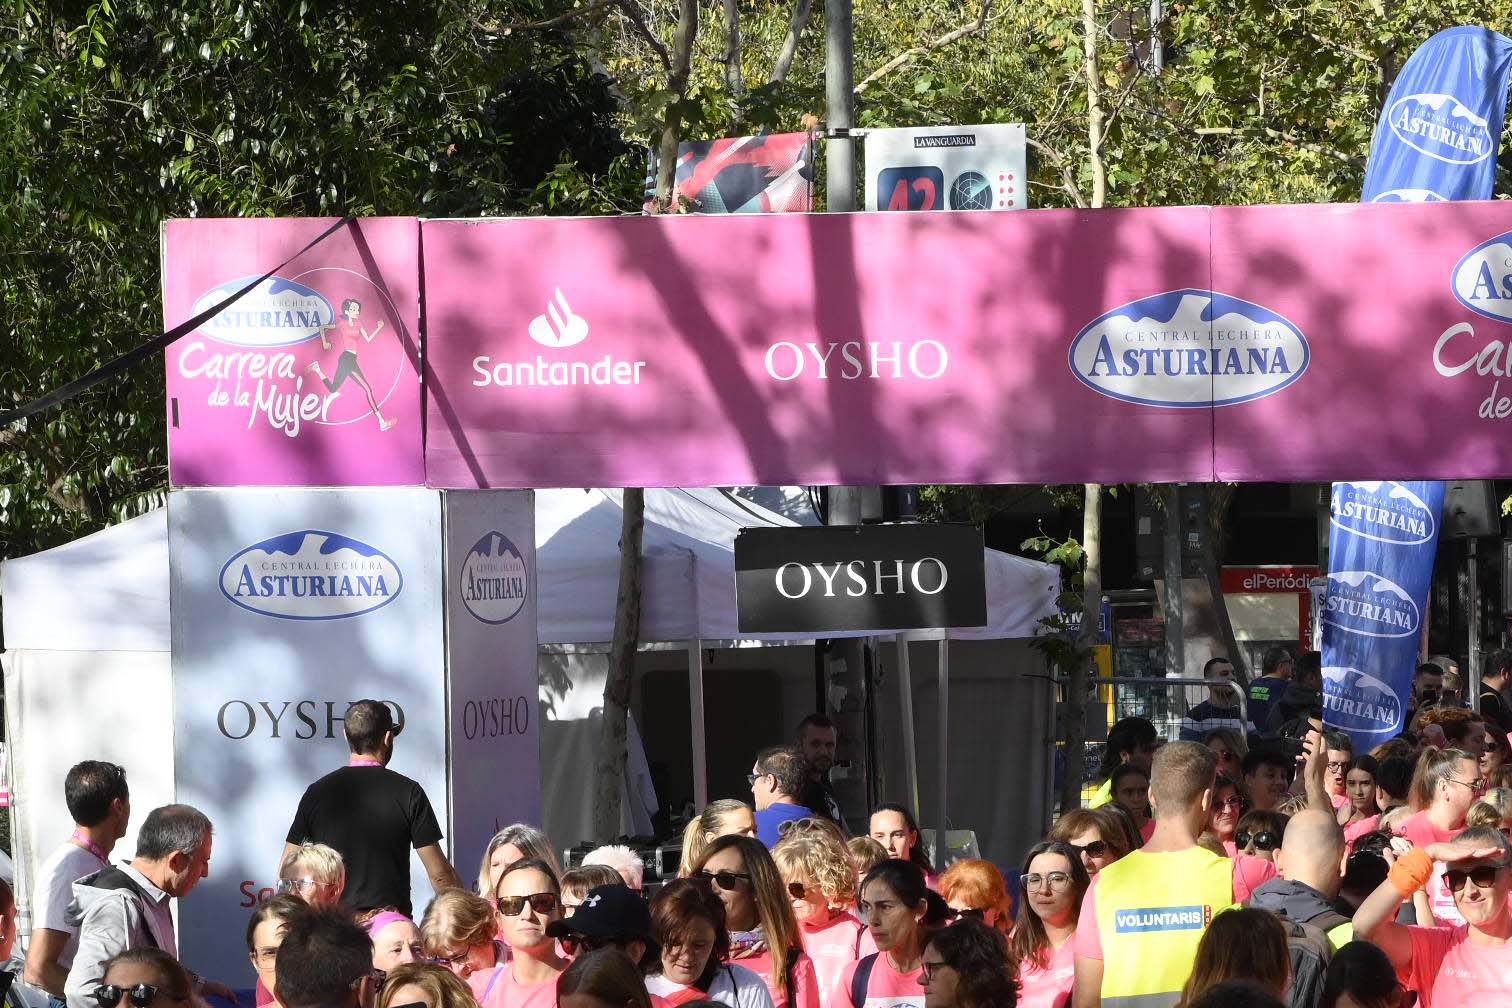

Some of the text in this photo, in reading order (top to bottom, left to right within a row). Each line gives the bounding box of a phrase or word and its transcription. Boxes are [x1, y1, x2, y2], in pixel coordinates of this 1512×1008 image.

[206, 301, 322, 328] STURIANA
[1124, 329, 1284, 342] CENTRAL LECHERA
[178, 341, 296, 378] Carrera
[472, 355, 646, 387] Santander
[765, 339, 948, 384] OYSHO
[1087, 334, 1292, 377] ASTURIANA
[207, 380, 251, 407] de la
[248, 375, 341, 438] Mujer
[1478, 379, 1512, 419] de
[1331, 492, 1427, 538] ASTURIANA
[234, 564, 389, 598] ASTURIANA
[261, 561, 384, 571] CENTRAL LECHERA
[466, 566, 524, 602] ASTURIANA
[774, 556, 949, 600] OYSHO
[463, 695, 529, 741] OYSHO
[1116, 910, 1202, 928] VOLUNTARIS
